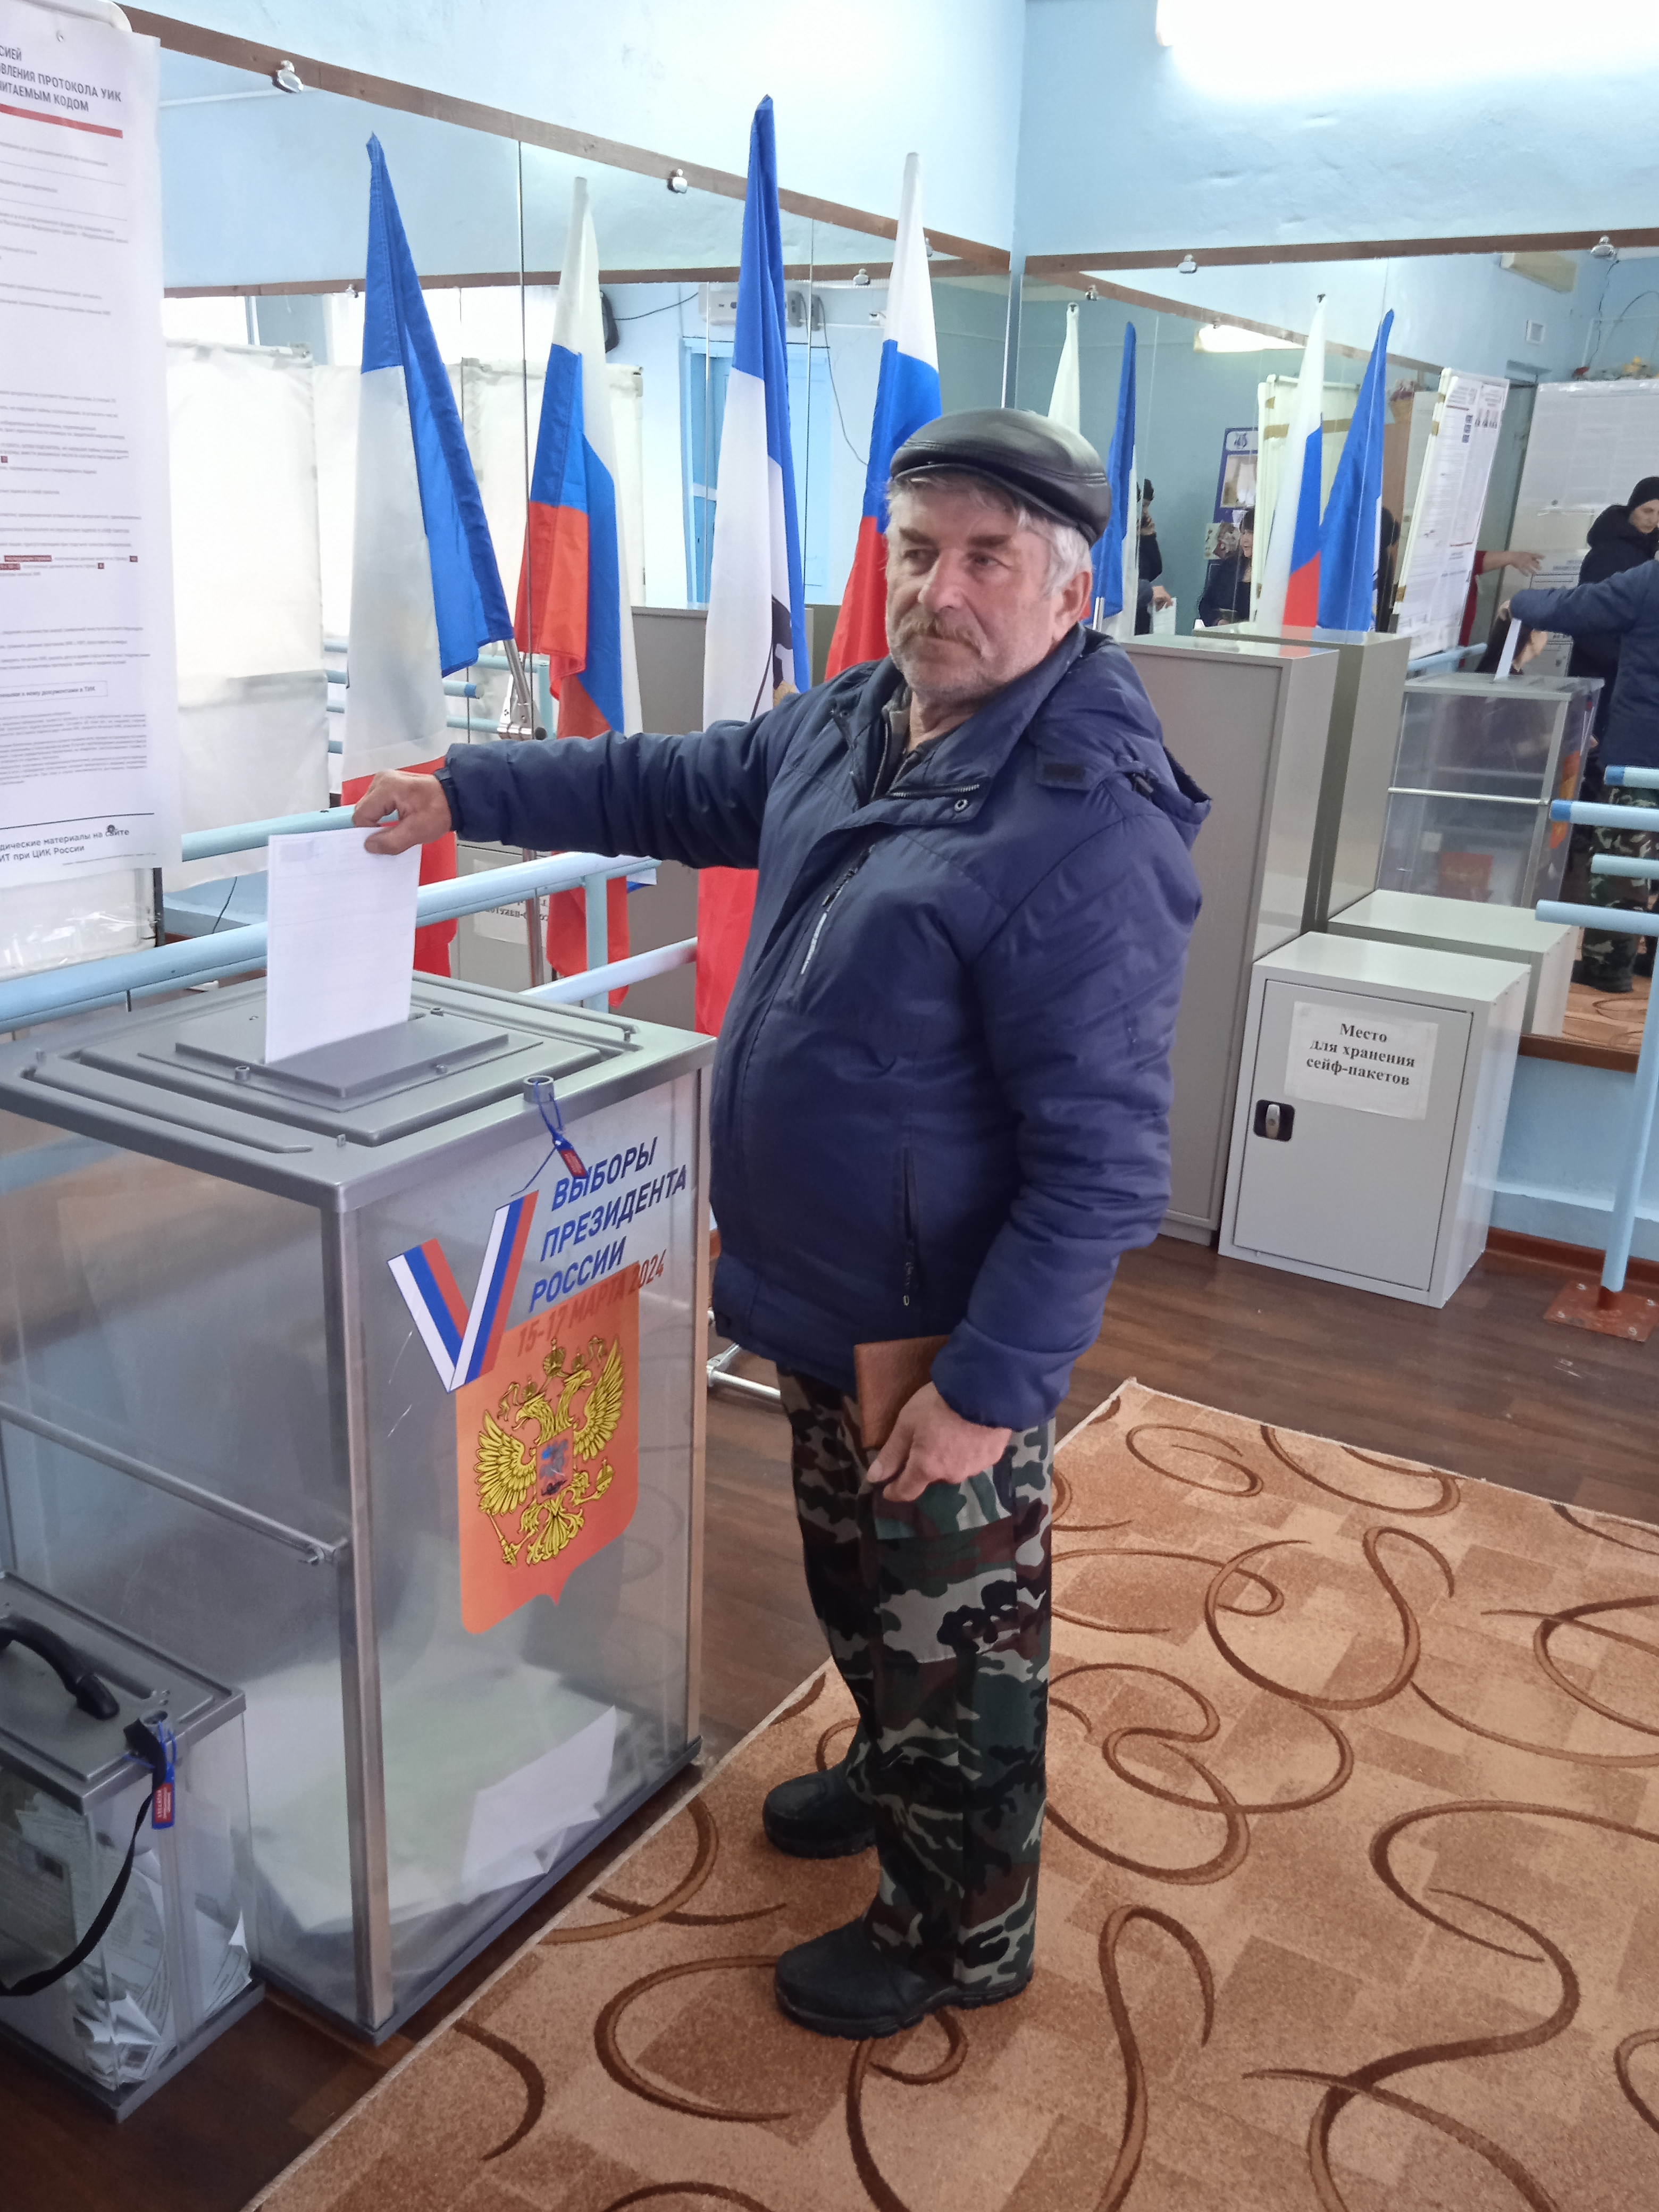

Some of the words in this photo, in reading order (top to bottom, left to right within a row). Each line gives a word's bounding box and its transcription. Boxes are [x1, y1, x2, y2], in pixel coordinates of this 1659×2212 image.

[0, 63, 35, 82] ВЛЕНИЯ
[38, 73, 98, 97] ПРОТОКОЛА
[100, 88, 122, 102] УИК
[53, 94, 89, 112] КОДОМ
[13, 852, 30, 861] при
[32, 848, 52, 859] ЦИК
[54, 845, 85, 855] России
[44, 833, 91, 845] материалы
[1339, 1023, 1388, 1043] Место
[1309, 1040, 1338, 1053] для
[1343, 1044, 1415, 1068] хранения
[1306, 1058, 1410, 1086] сейф-пакетов
[551, 1136, 658, 1212] ВЫБОРЫ
[540, 1164, 686, 1262] ПРЕЗИДЕНТА
[529, 1236, 627, 1313] РОССИИ
[517, 1304, 568, 1357] 15-17
[568, 1271, 626, 1328] МАРТА
[628, 1249, 666, 1295] 2024
